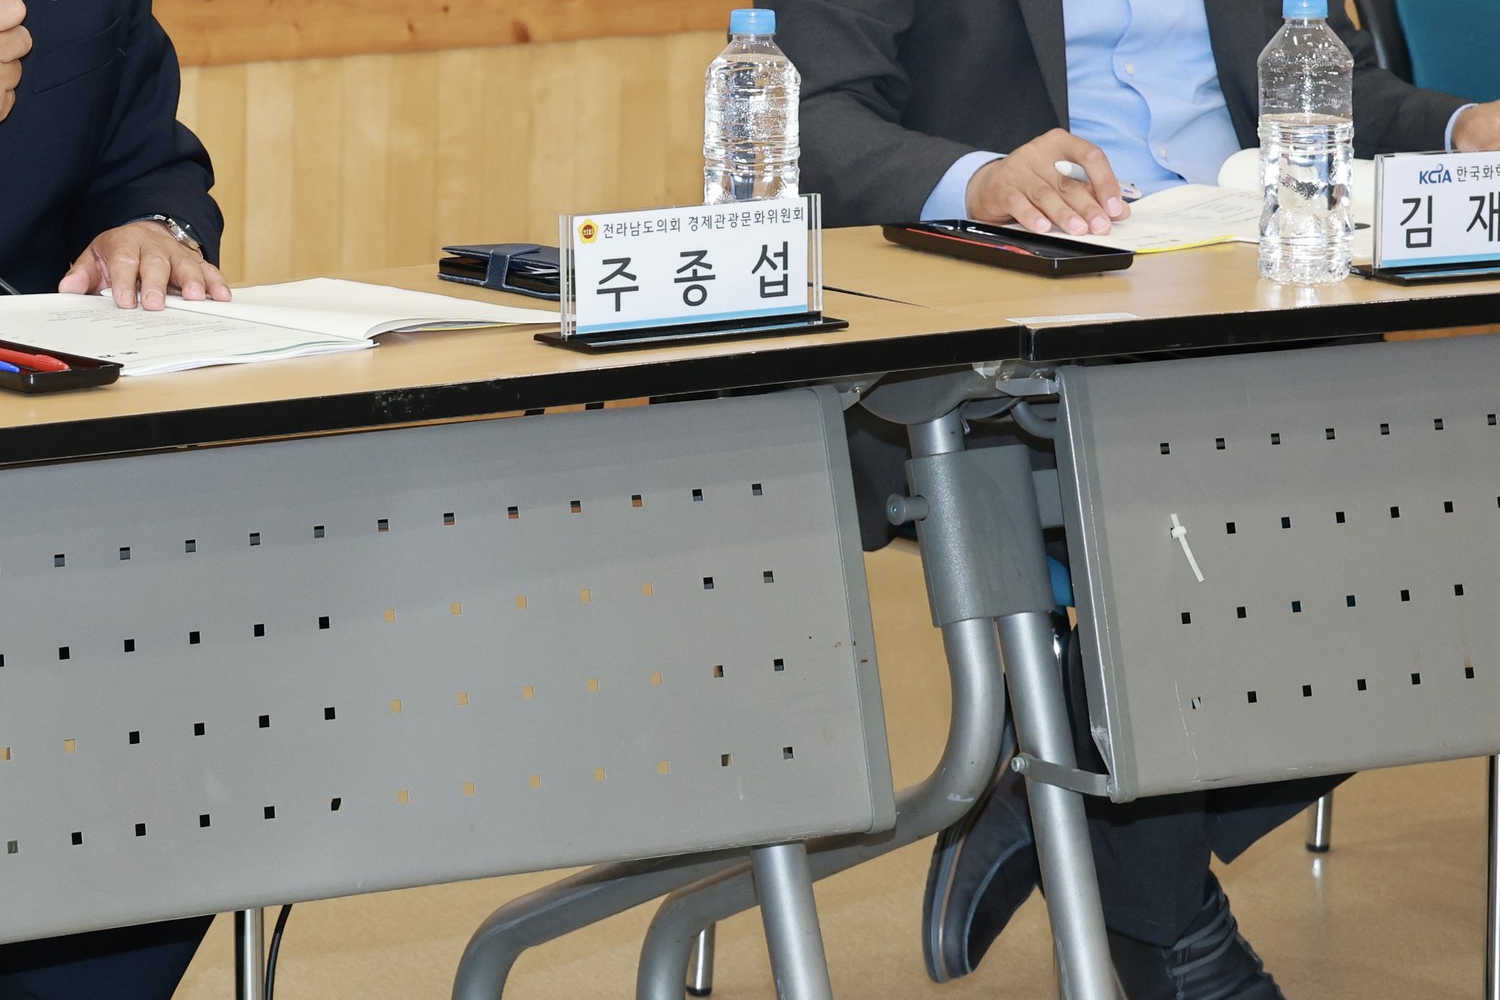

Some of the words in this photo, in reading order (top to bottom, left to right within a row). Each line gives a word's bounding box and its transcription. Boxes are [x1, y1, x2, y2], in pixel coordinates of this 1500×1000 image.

[602, 217, 681, 239] 전라남도의회
[688, 206, 804, 232] 경제관광문화위원회
[1400, 195, 1433, 248] 김
[596, 257, 639, 312] 주
[673, 250, 716, 307] 종
[751, 241, 789, 299] 섭
